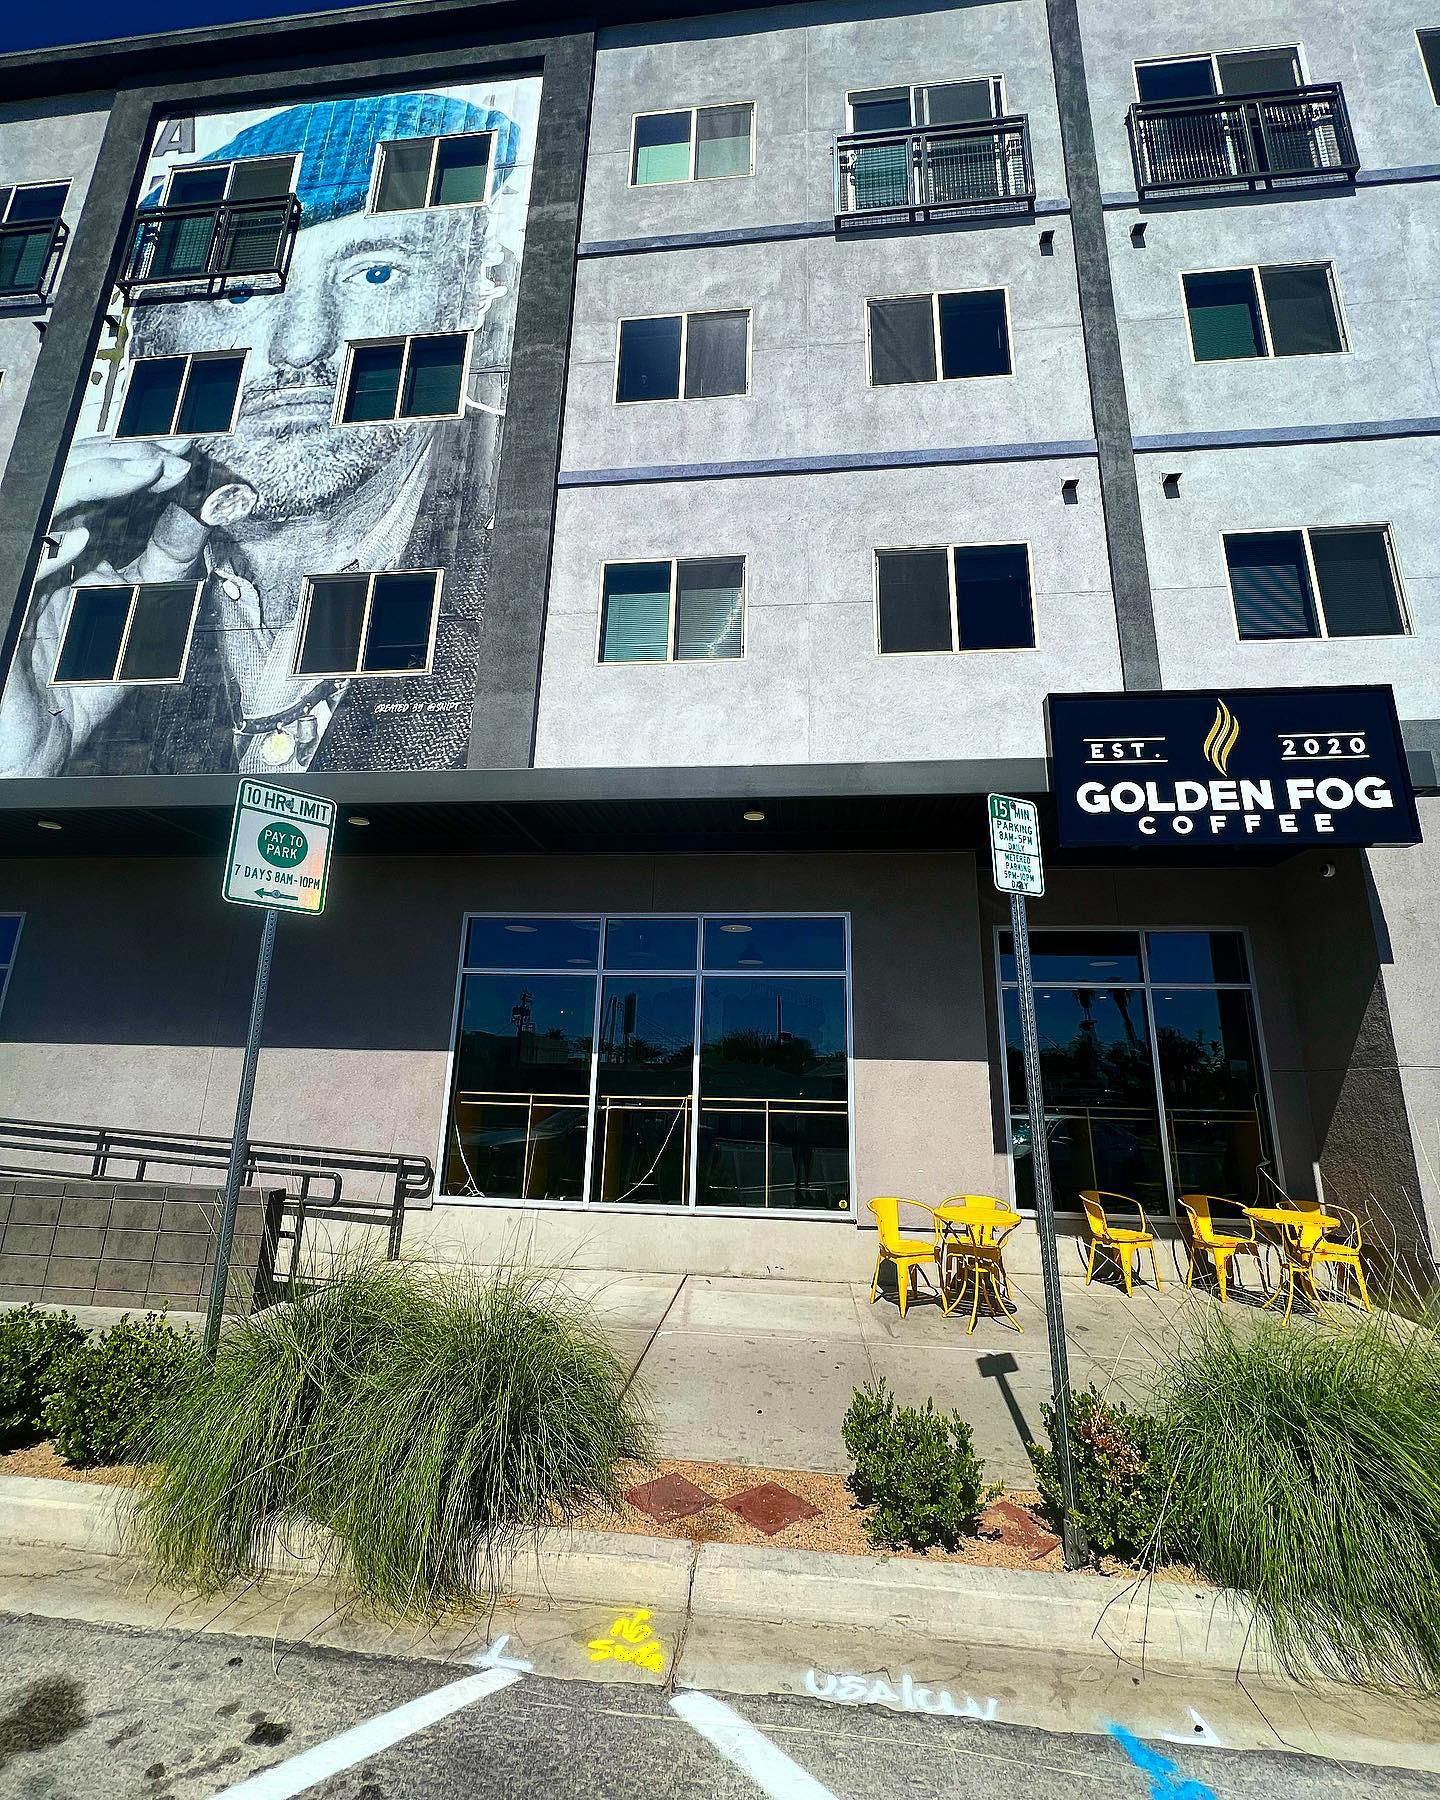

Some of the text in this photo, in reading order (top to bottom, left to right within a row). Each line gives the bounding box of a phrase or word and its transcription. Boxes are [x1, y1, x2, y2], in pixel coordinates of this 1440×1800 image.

[374, 703, 409, 713] CREATED
[412, 702, 424, 712] BY
[1091, 742, 1161, 759] EST.
[1282, 738, 1366, 756] 2020
[1076, 776, 1394, 814] GOLDEN FOG
[247, 787, 329, 821] 10 HR LIMIT
[993, 799, 1008, 818] 15
[997, 821, 1033, 836] PARKING
[1138, 813, 1335, 834] COFFEE
[264, 829, 303, 848] PAY TO
[1008, 842, 1025, 852] DAILY
[266, 843, 298, 860] PARK
[1004, 854, 1031, 864] METERED
[234, 864, 241, 876] 7
[244, 866, 273, 881] DAYS
[1006, 862, 1031, 873] PARKING
[1012, 881, 1029, 890] DALY
